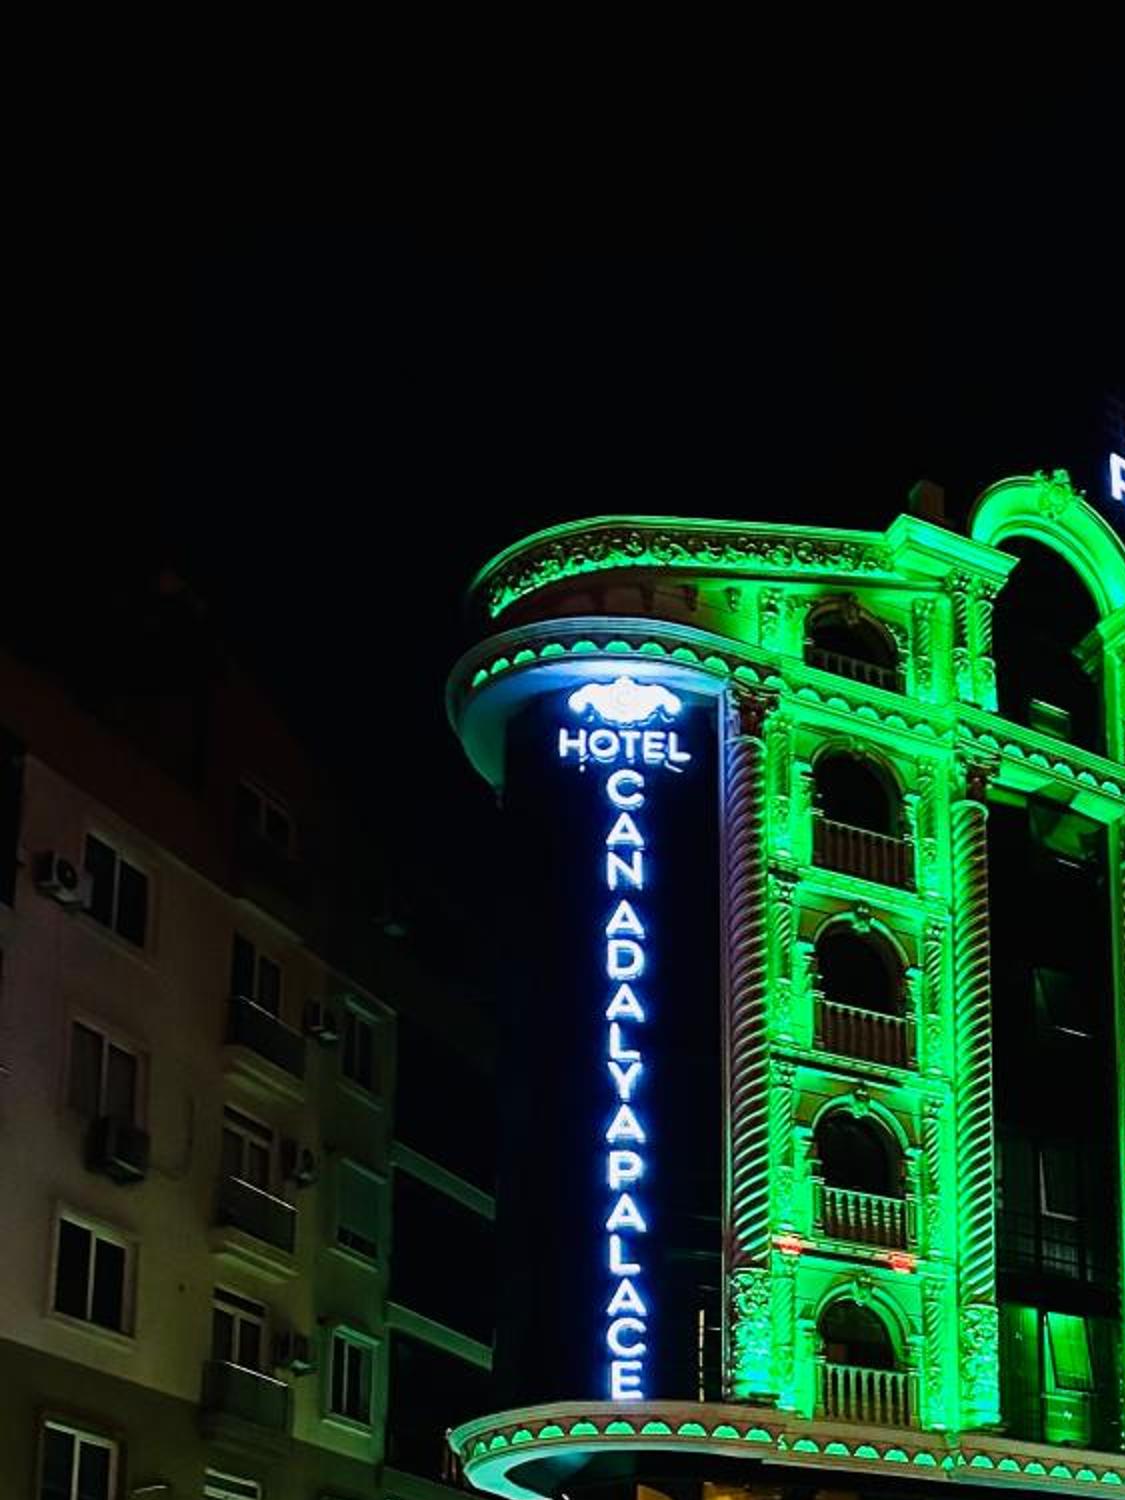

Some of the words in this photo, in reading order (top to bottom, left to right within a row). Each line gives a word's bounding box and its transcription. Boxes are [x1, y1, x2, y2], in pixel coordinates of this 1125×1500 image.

[559, 728, 692, 763] HOTEL
[606, 769, 645, 890] CAN
[606, 899, 645, 1143] ADALYA
[606, 1150, 646, 1401] PALACE
